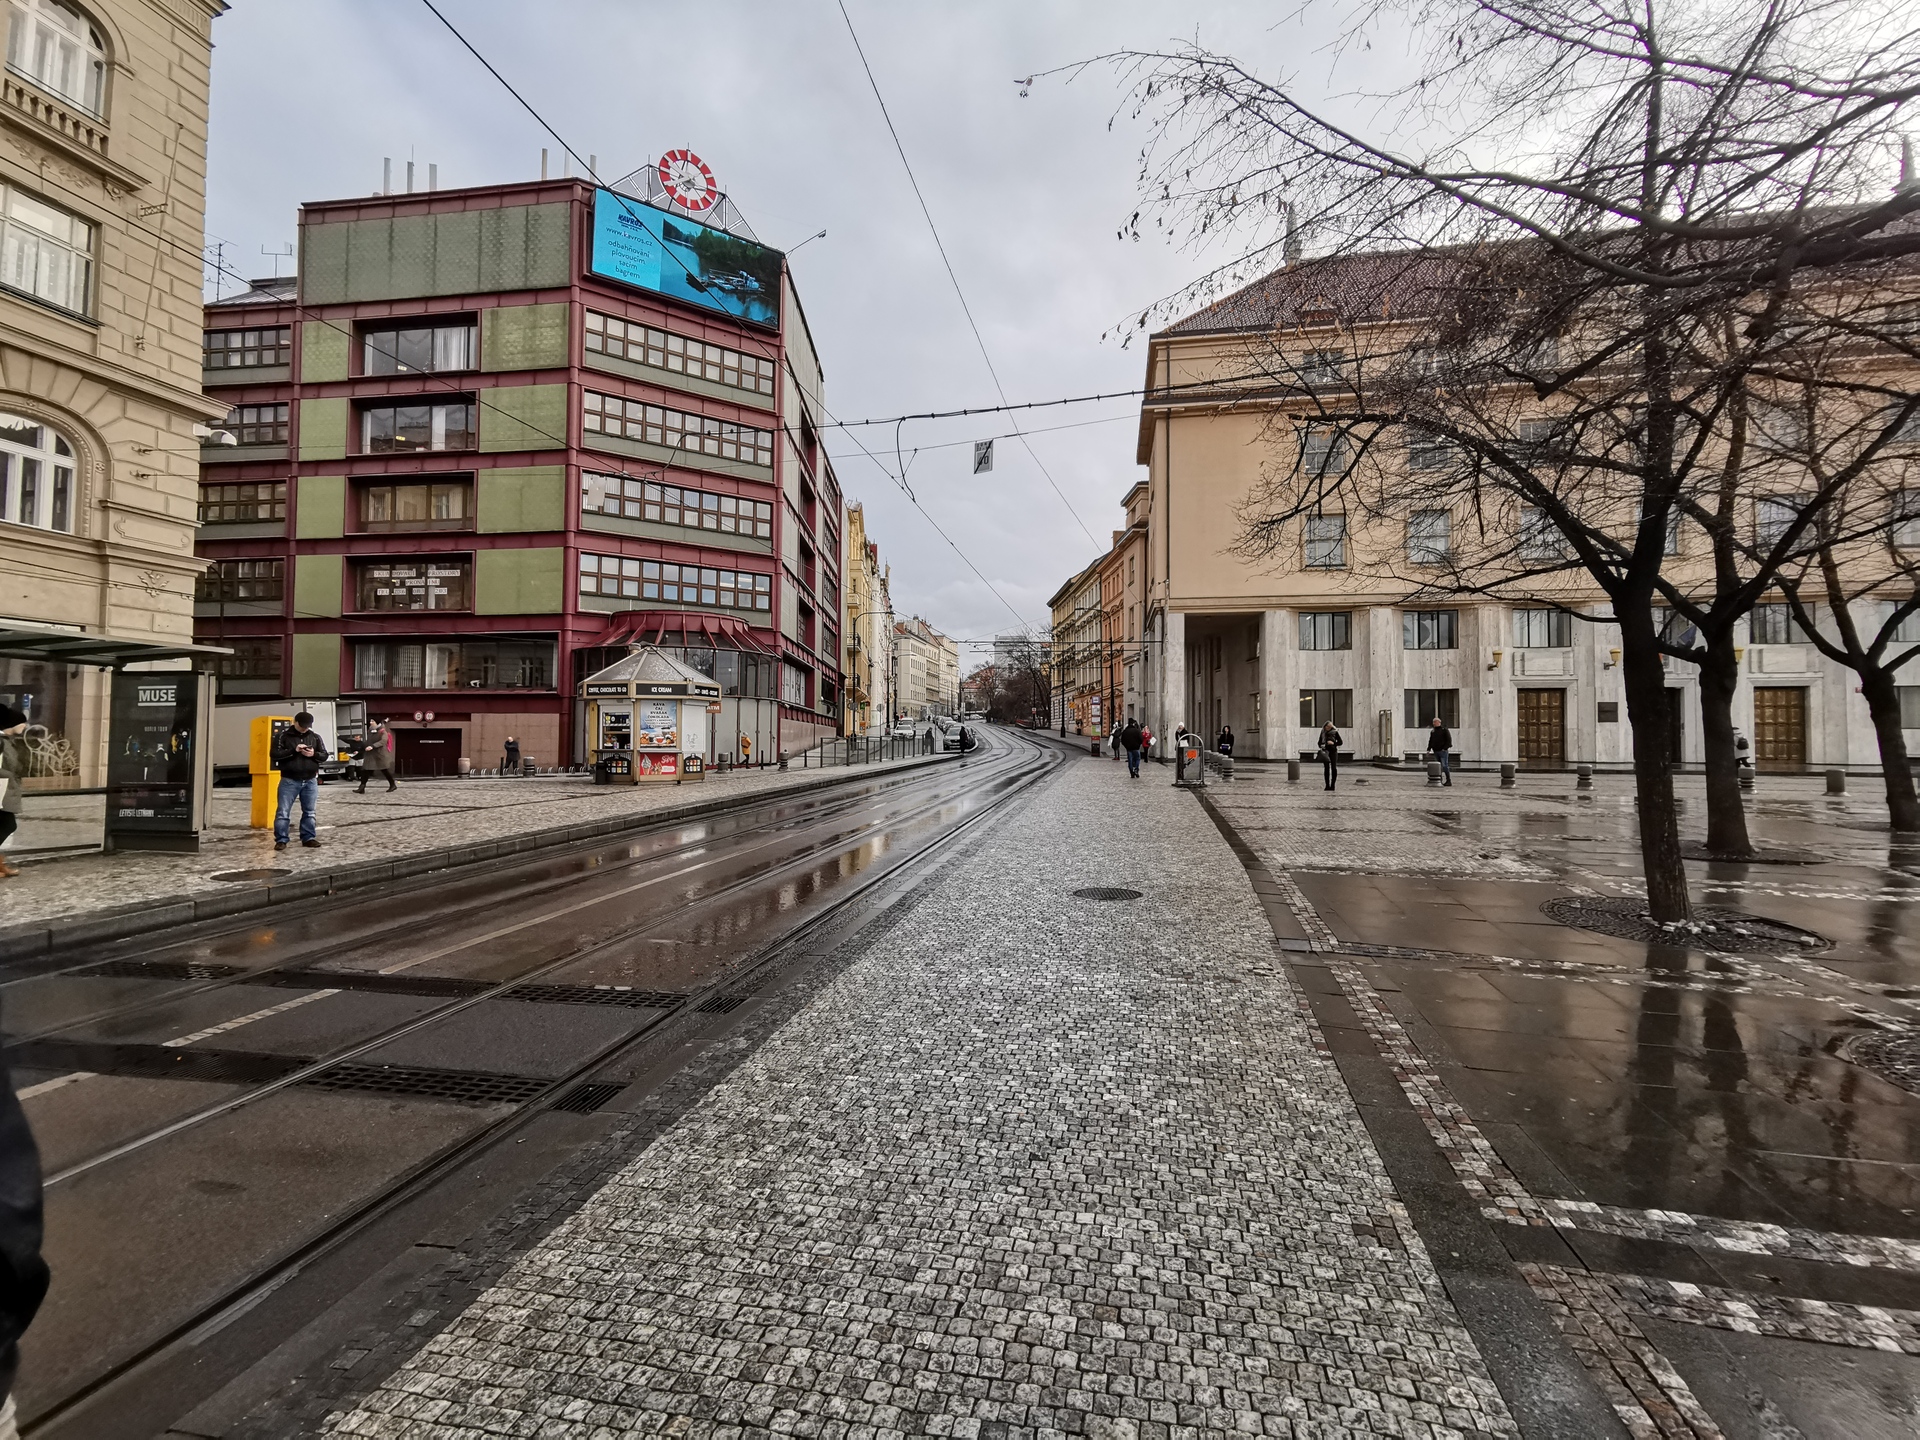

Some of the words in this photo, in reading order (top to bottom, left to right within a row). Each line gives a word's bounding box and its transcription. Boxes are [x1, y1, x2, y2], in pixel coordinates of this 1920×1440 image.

[605, 226, 653, 247] www.kavros.cz
[611, 249, 646, 265] plovoucím
[138, 689, 176, 702] MUSE
